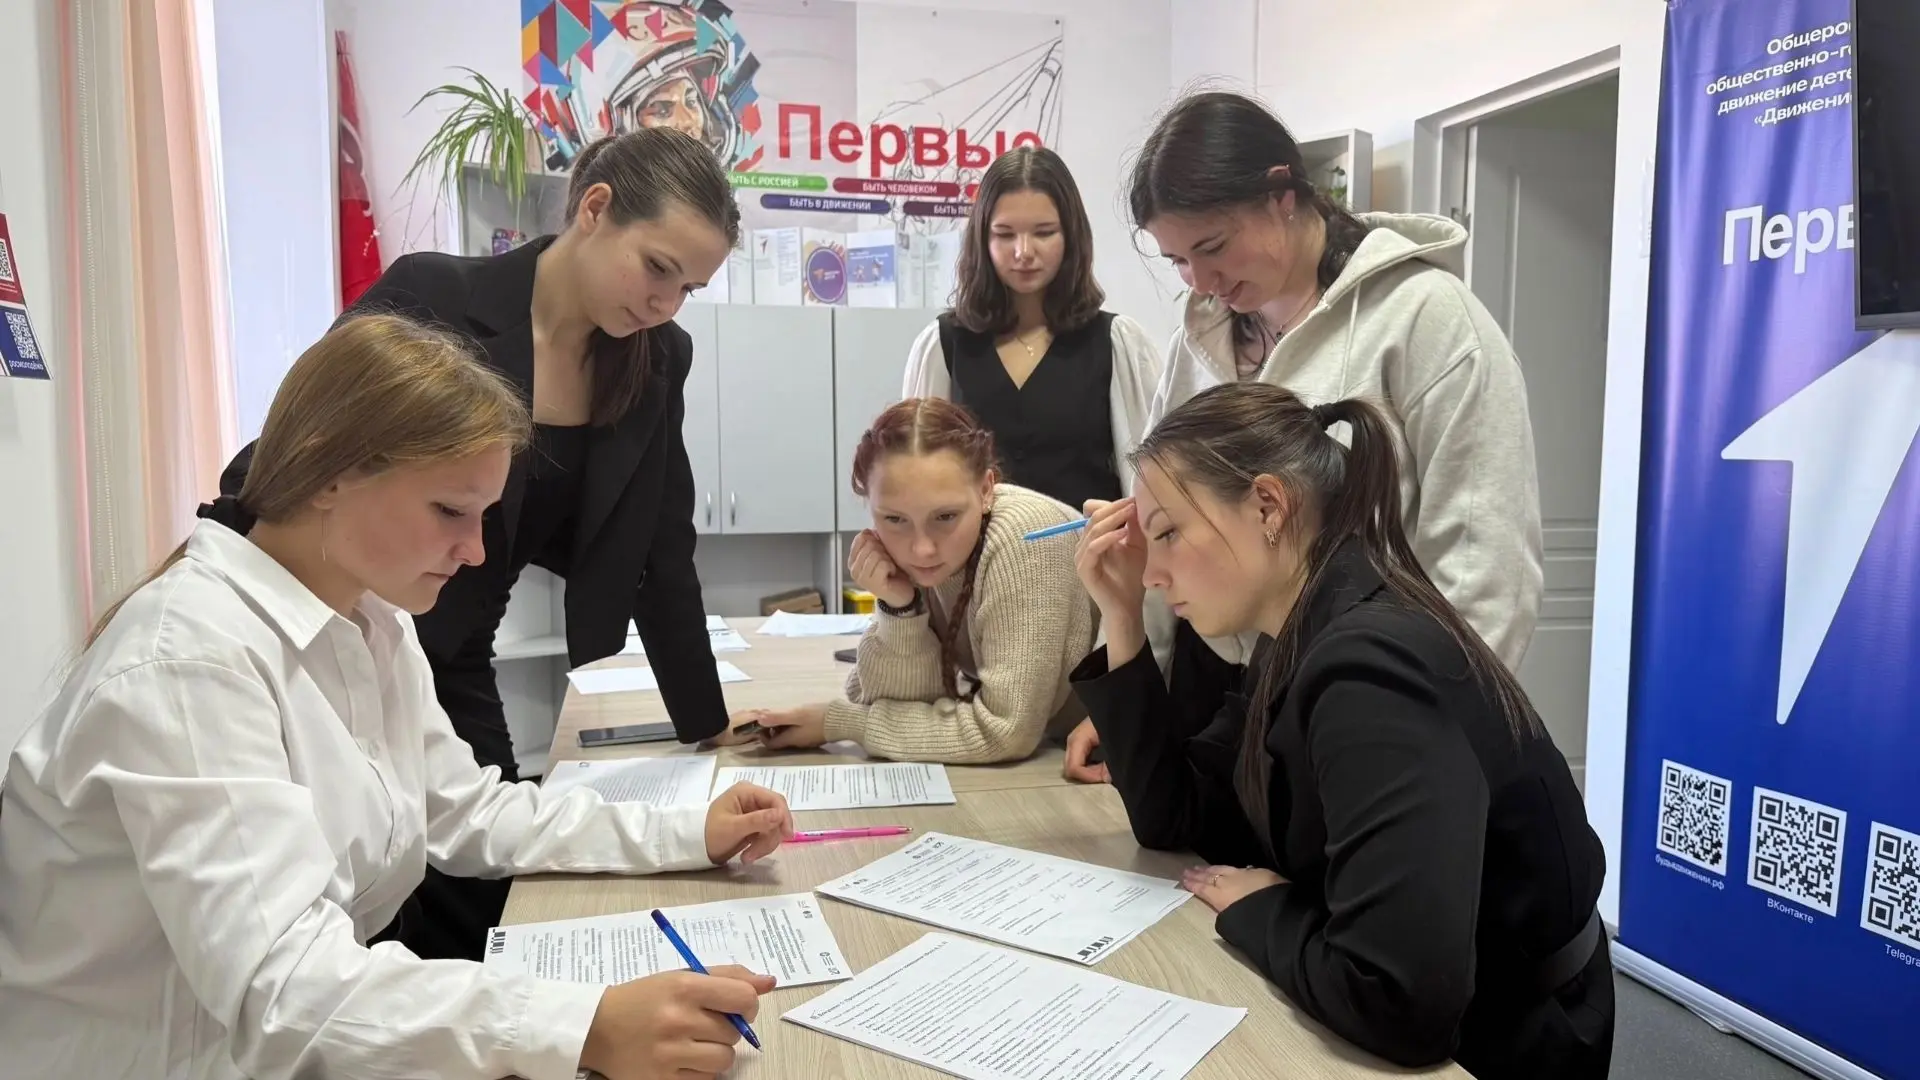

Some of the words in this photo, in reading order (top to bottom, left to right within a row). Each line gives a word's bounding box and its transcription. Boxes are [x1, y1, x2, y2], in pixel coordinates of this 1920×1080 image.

[1767, 20, 1852, 55] Общеро
[1717, 79, 1808, 115] движение
[1754, 91, 1852, 127] «Движени
[758, 176, 799, 188] РОССИЕЙ
[862, 181, 886, 192] БЫТЬ
[889, 183, 938, 194] ЧЕЛОВЕКОМ
[789, 198, 813, 208] БЫТЬ
[822, 199, 871, 211] ДВИЖЕНИИ
[933, 204, 957, 214] БЫТЬ
[1766, 897, 1814, 924] ВКонтакте
